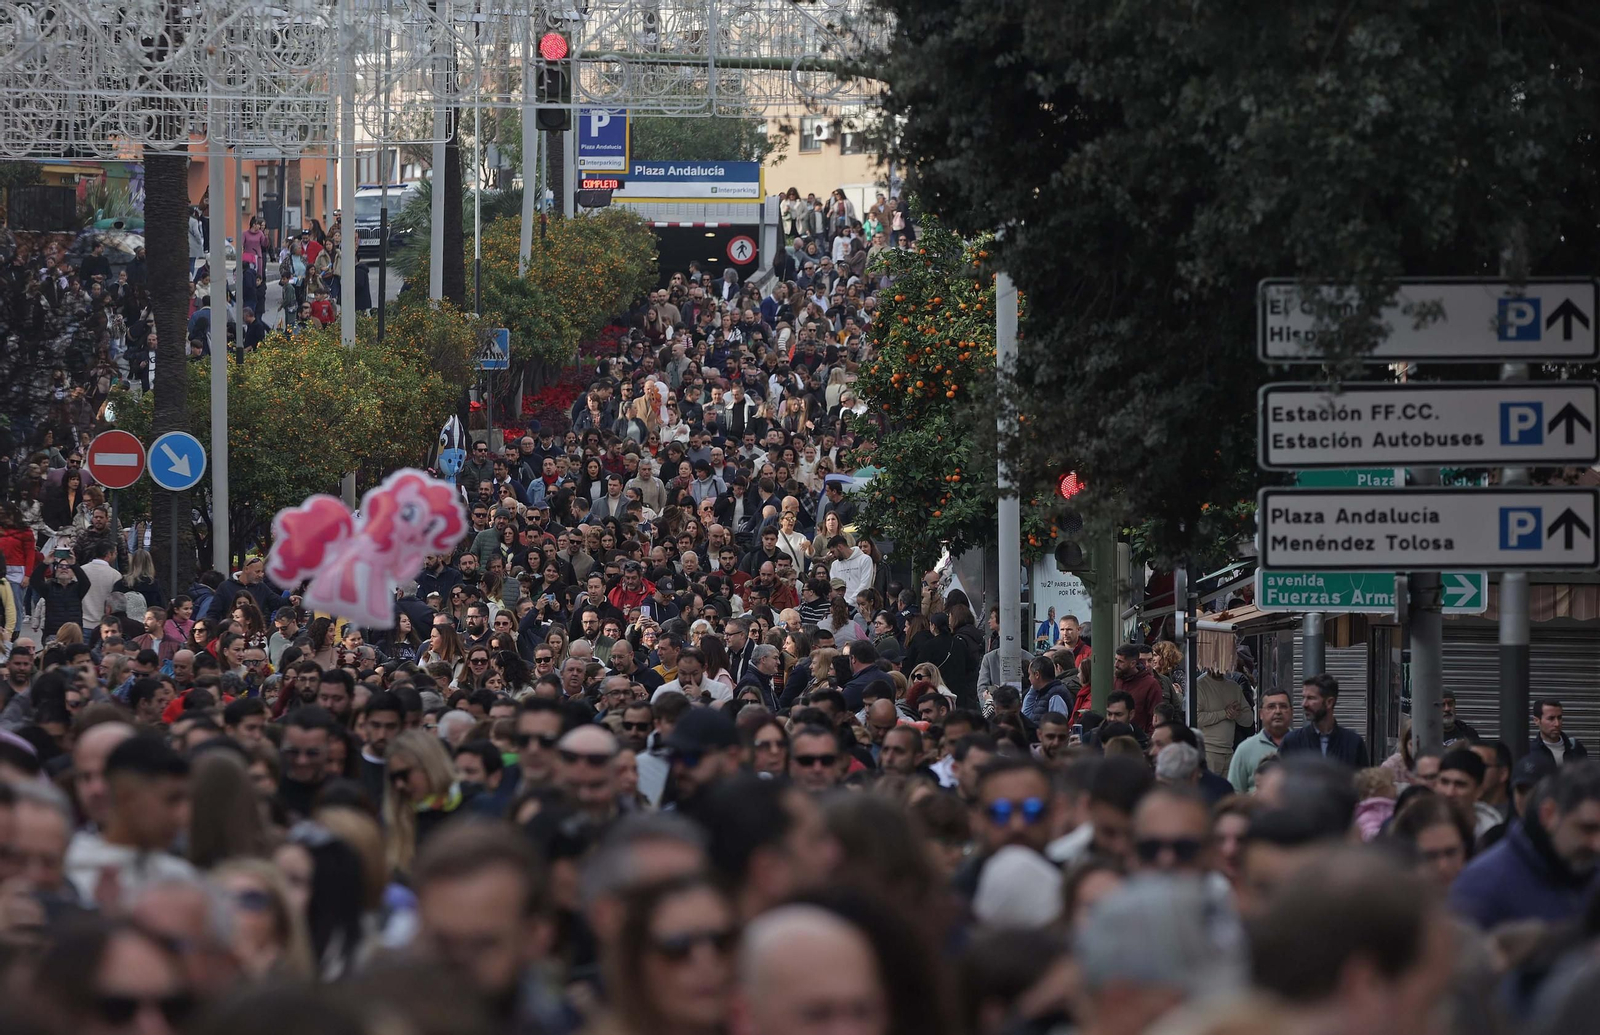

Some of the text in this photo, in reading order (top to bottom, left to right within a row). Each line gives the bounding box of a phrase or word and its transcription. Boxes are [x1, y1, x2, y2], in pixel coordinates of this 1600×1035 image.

[634, 165, 725, 176] Plaza Andalucía
[583, 180, 618, 188] COMPLETO
[1272, 403, 1440, 423] Estación FF.CC.
[1272, 431, 1484, 449] Estación Autobuses
[1271, 507, 1440, 524] Plaza Andalucía
[1271, 535, 1455, 551] Menéndez Tolosa
[1267, 575, 1325, 588] avenida
[1267, 589, 1341, 605] Fuerzas
